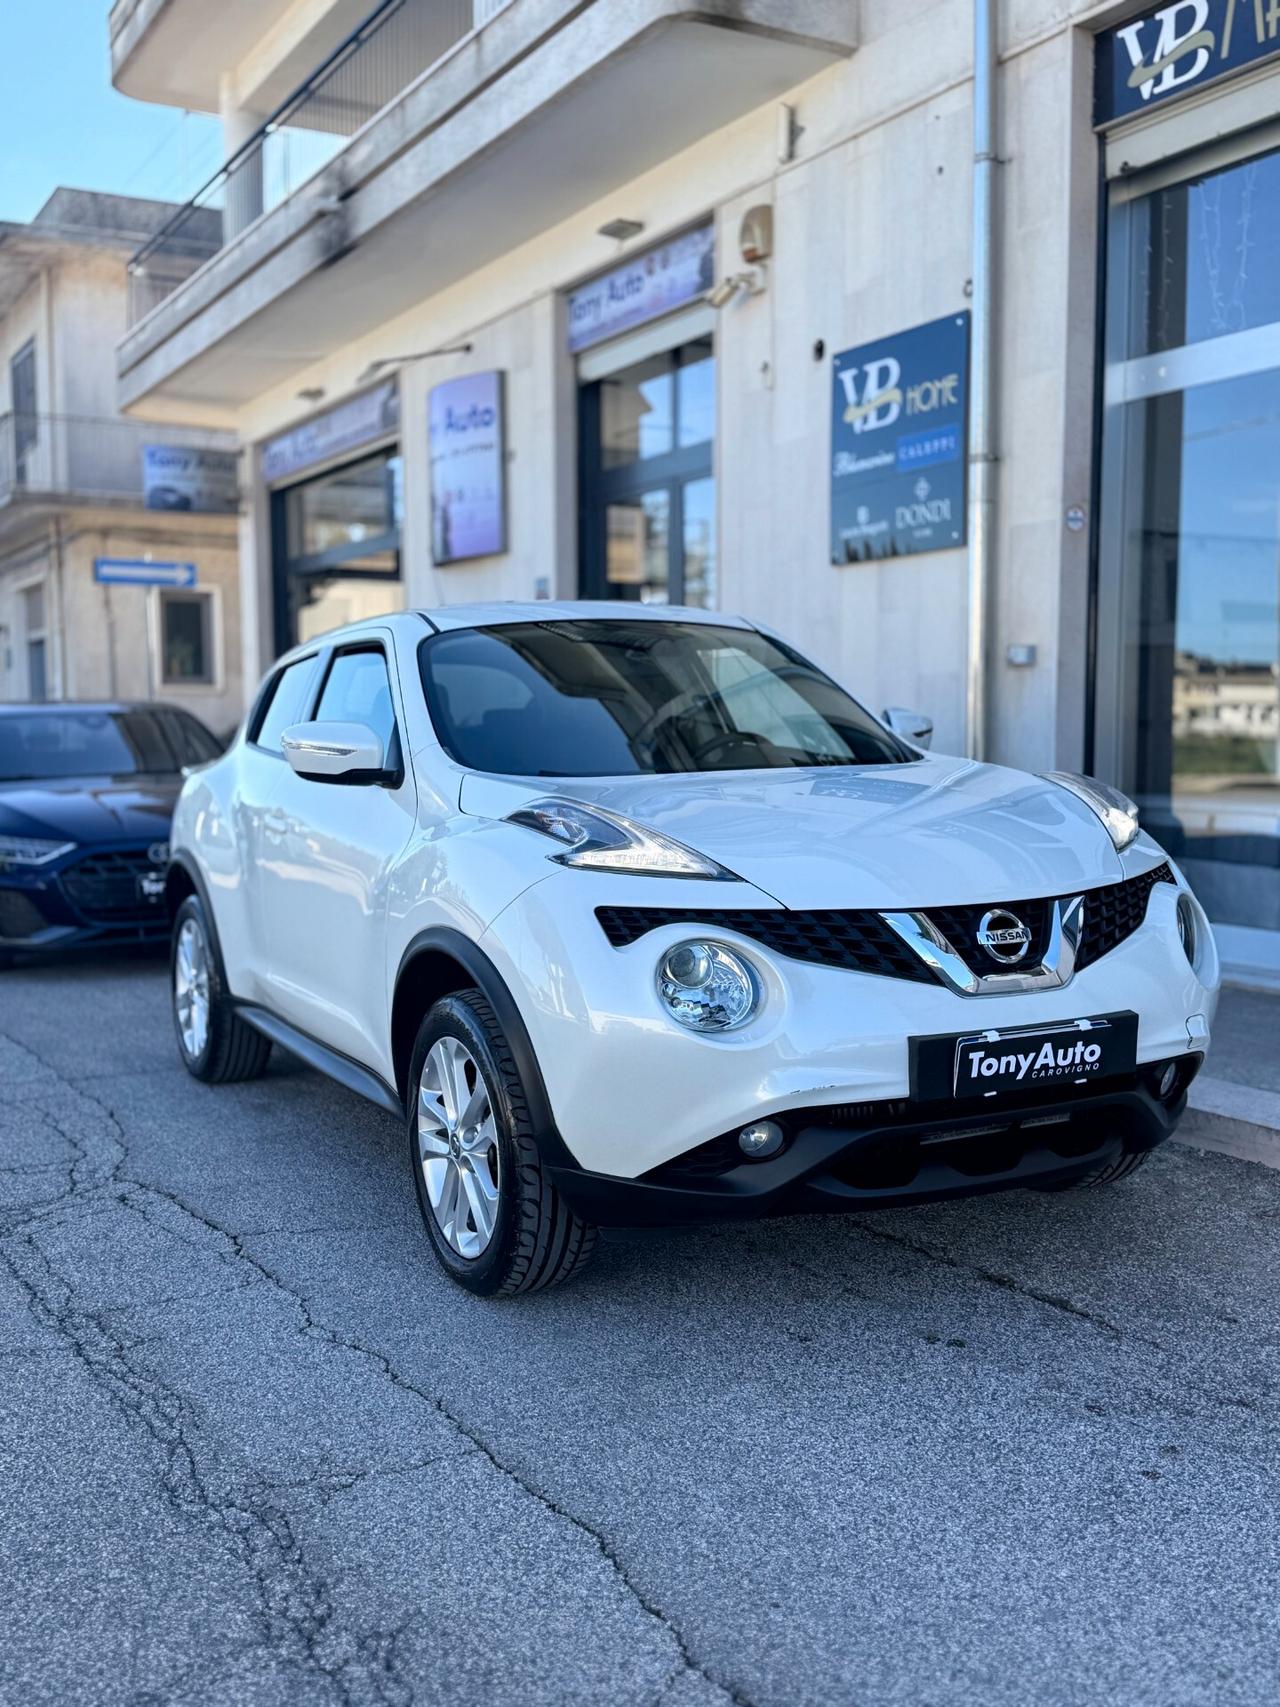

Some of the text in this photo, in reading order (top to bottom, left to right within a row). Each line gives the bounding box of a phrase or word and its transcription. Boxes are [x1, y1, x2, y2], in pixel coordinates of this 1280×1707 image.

[838, 357, 959, 434] VB HOME
[446, 403, 496, 433] Auto
[985, 930, 1029, 942] NISSAN
[1031, 1062, 1101, 1079] CAROVIGNO
